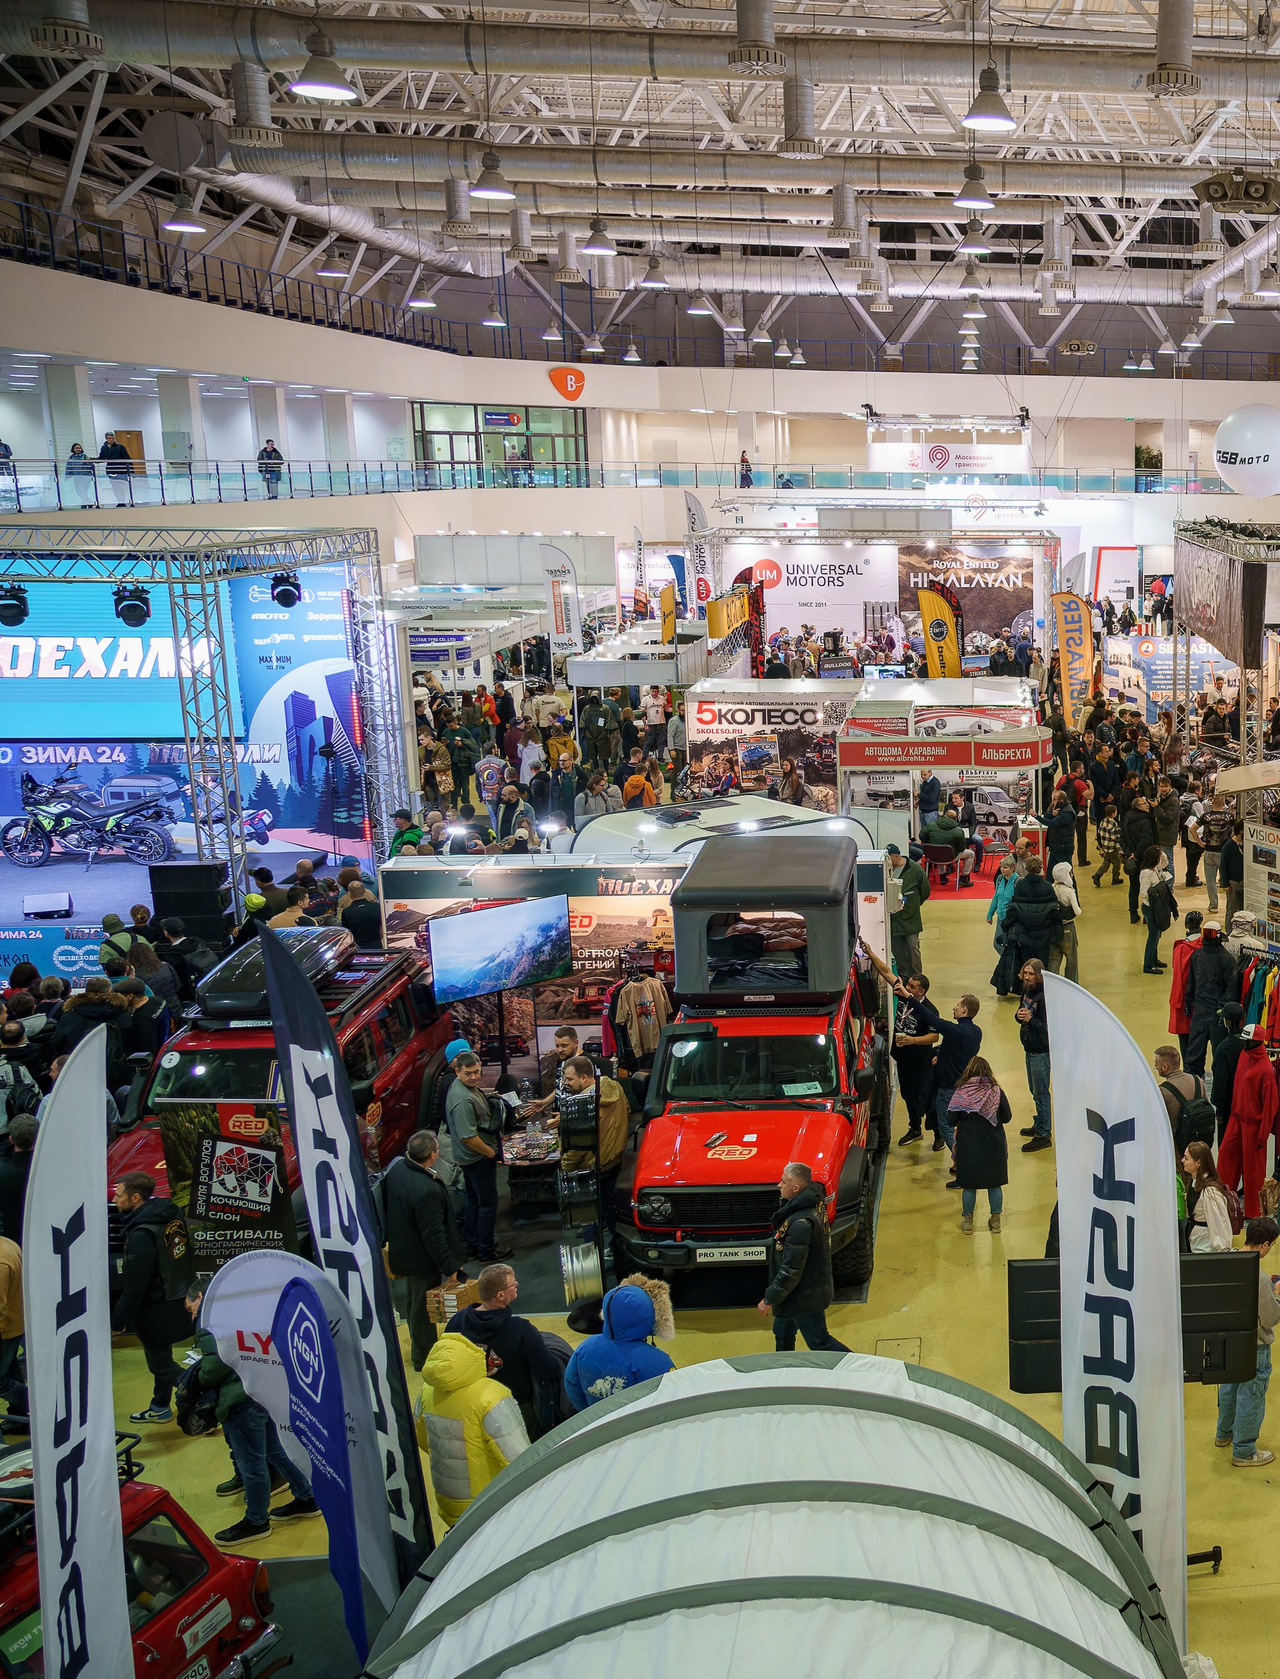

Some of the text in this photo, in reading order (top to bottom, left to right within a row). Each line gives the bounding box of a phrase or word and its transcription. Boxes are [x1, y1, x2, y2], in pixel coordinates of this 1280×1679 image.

[566, 375, 576, 391] B
[786, 564, 864, 576] UNIVERSAL
[933, 559, 999, 570] ROYAL ENFIELD
[756, 569, 778, 581] UM
[909, 572, 1023, 588] HIMALAYAN
[786, 576, 845, 587] MOTORS
[824, 660, 852, 669] BULLDOG
[21, 746, 89, 764] ЗИМА
[96, 746, 127, 764] 24
[864, 747, 902, 756] АВТОДОМА
[909, 746, 947, 756] КАРАВАНЫ
[981, 748, 1032, 761] АЛЬБРЕХТА
[28, 930, 43, 939] 24
[231, 1120, 265, 1130] RED
[710, 1148, 754, 1158] RED
[196, 1139, 213, 1216] ЗЕМЛЯ ВОГУЛОВ
[210, 1195, 271, 1213] КОЧУЮЩИЙ
[208, 1211, 241, 1222] СЛОН
[194, 1230, 283, 1241] ФЕСТИВАЛЬ
[193, 1240, 284, 1249] ЭТНОГРАФИЧЕСКИХ
[698, 1251, 715, 1259] PRO
[293, 1332, 319, 1372] NGN
[240, 1355, 270, 1365] SPARE
